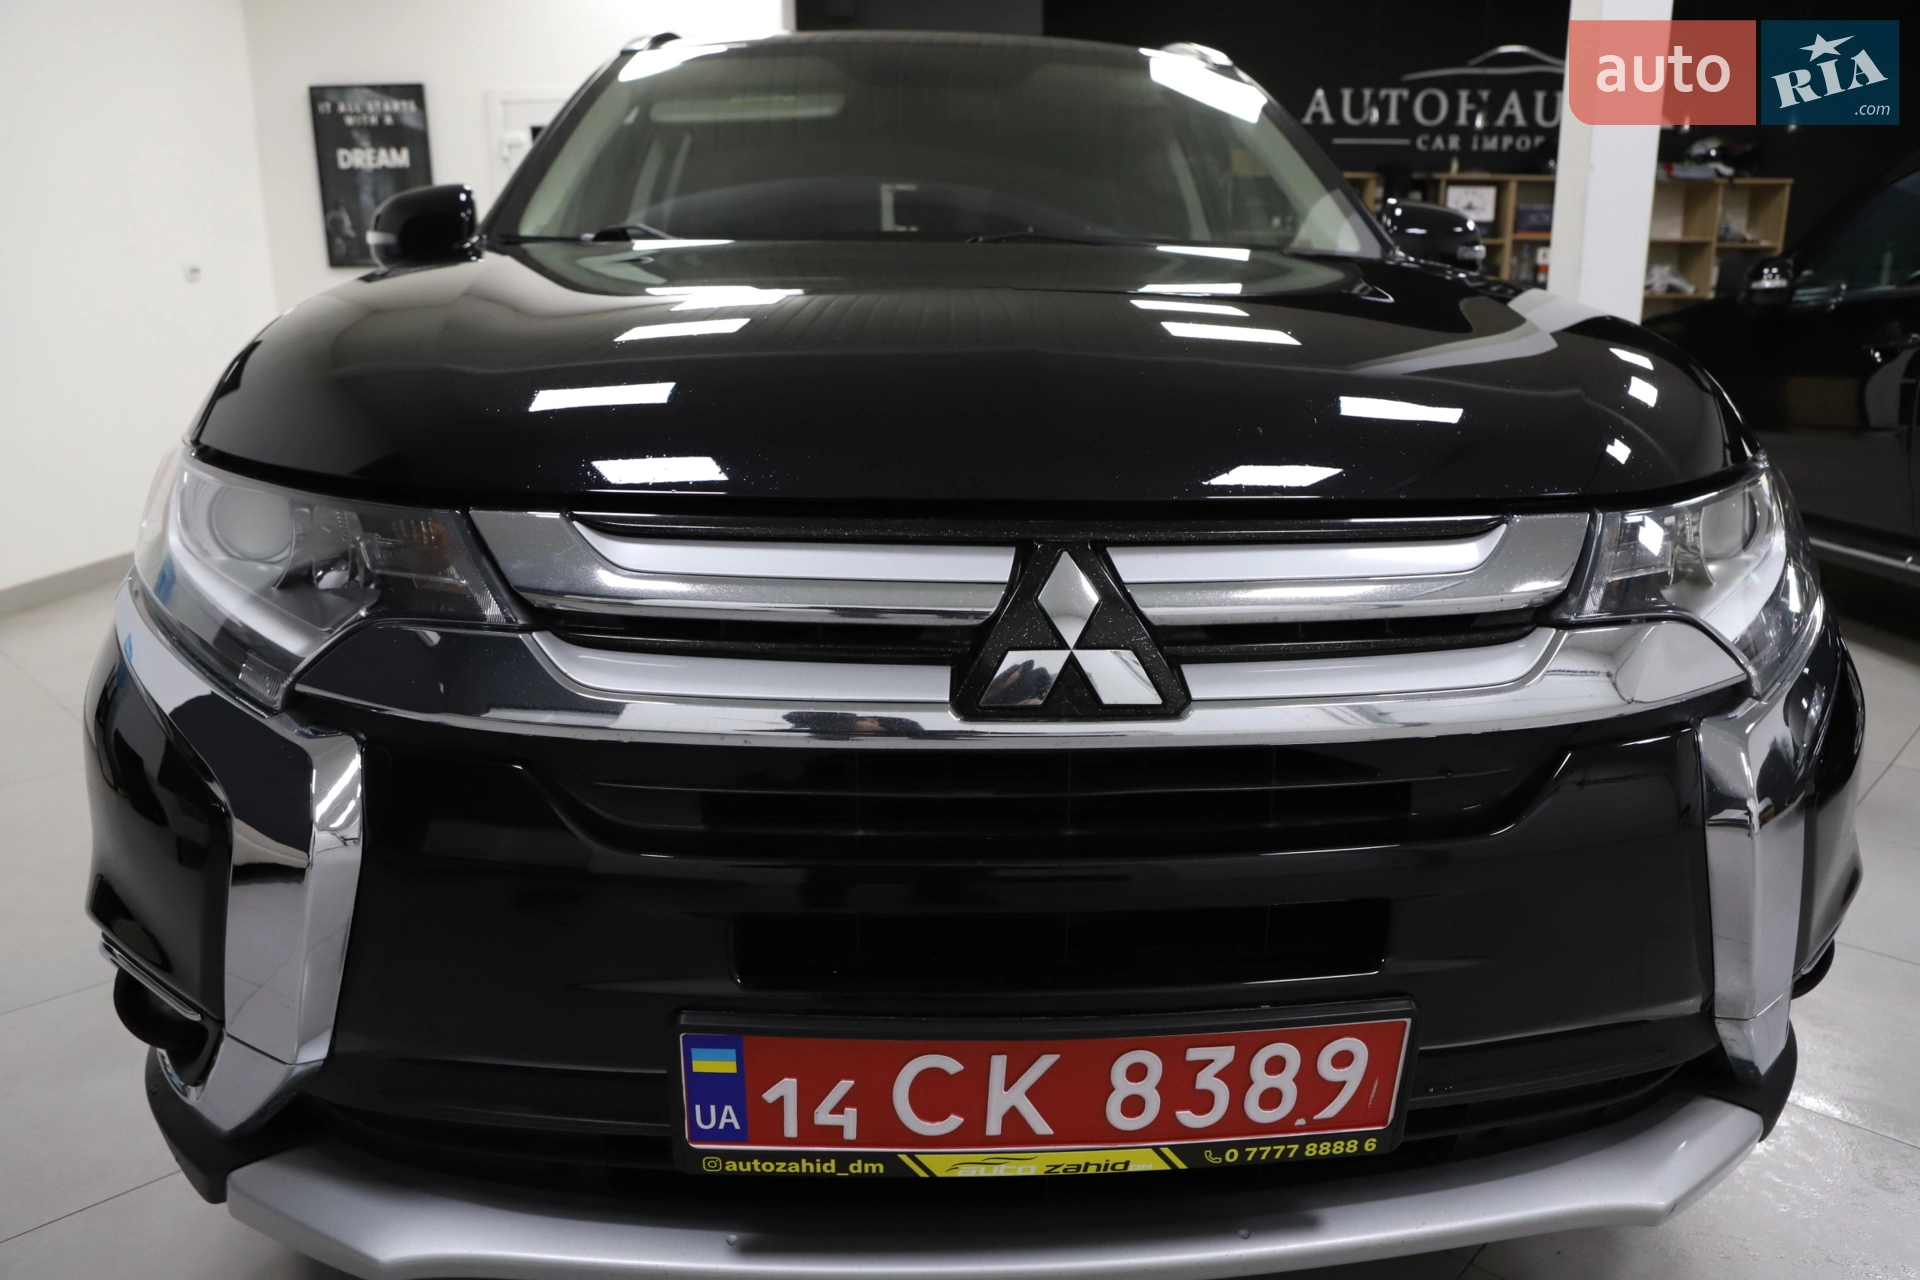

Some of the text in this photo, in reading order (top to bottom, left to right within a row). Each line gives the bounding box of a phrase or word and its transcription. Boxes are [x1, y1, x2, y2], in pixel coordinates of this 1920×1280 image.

[317, 100, 417, 114] IT ALL STARTS
[343, 114, 394, 127] WITH A
[1415, 133, 1462, 151] CAR
[336, 147, 411, 170] DREAM
[761, 1037, 1369, 1140] 14 CK 8389
[694, 1104, 741, 1130] UA
[1224, 1137, 1378, 1163] 0 7777 8888 6
[724, 1158, 884, 1176] autozahid_dm
[956, 1163, 1037, 1177] auto
